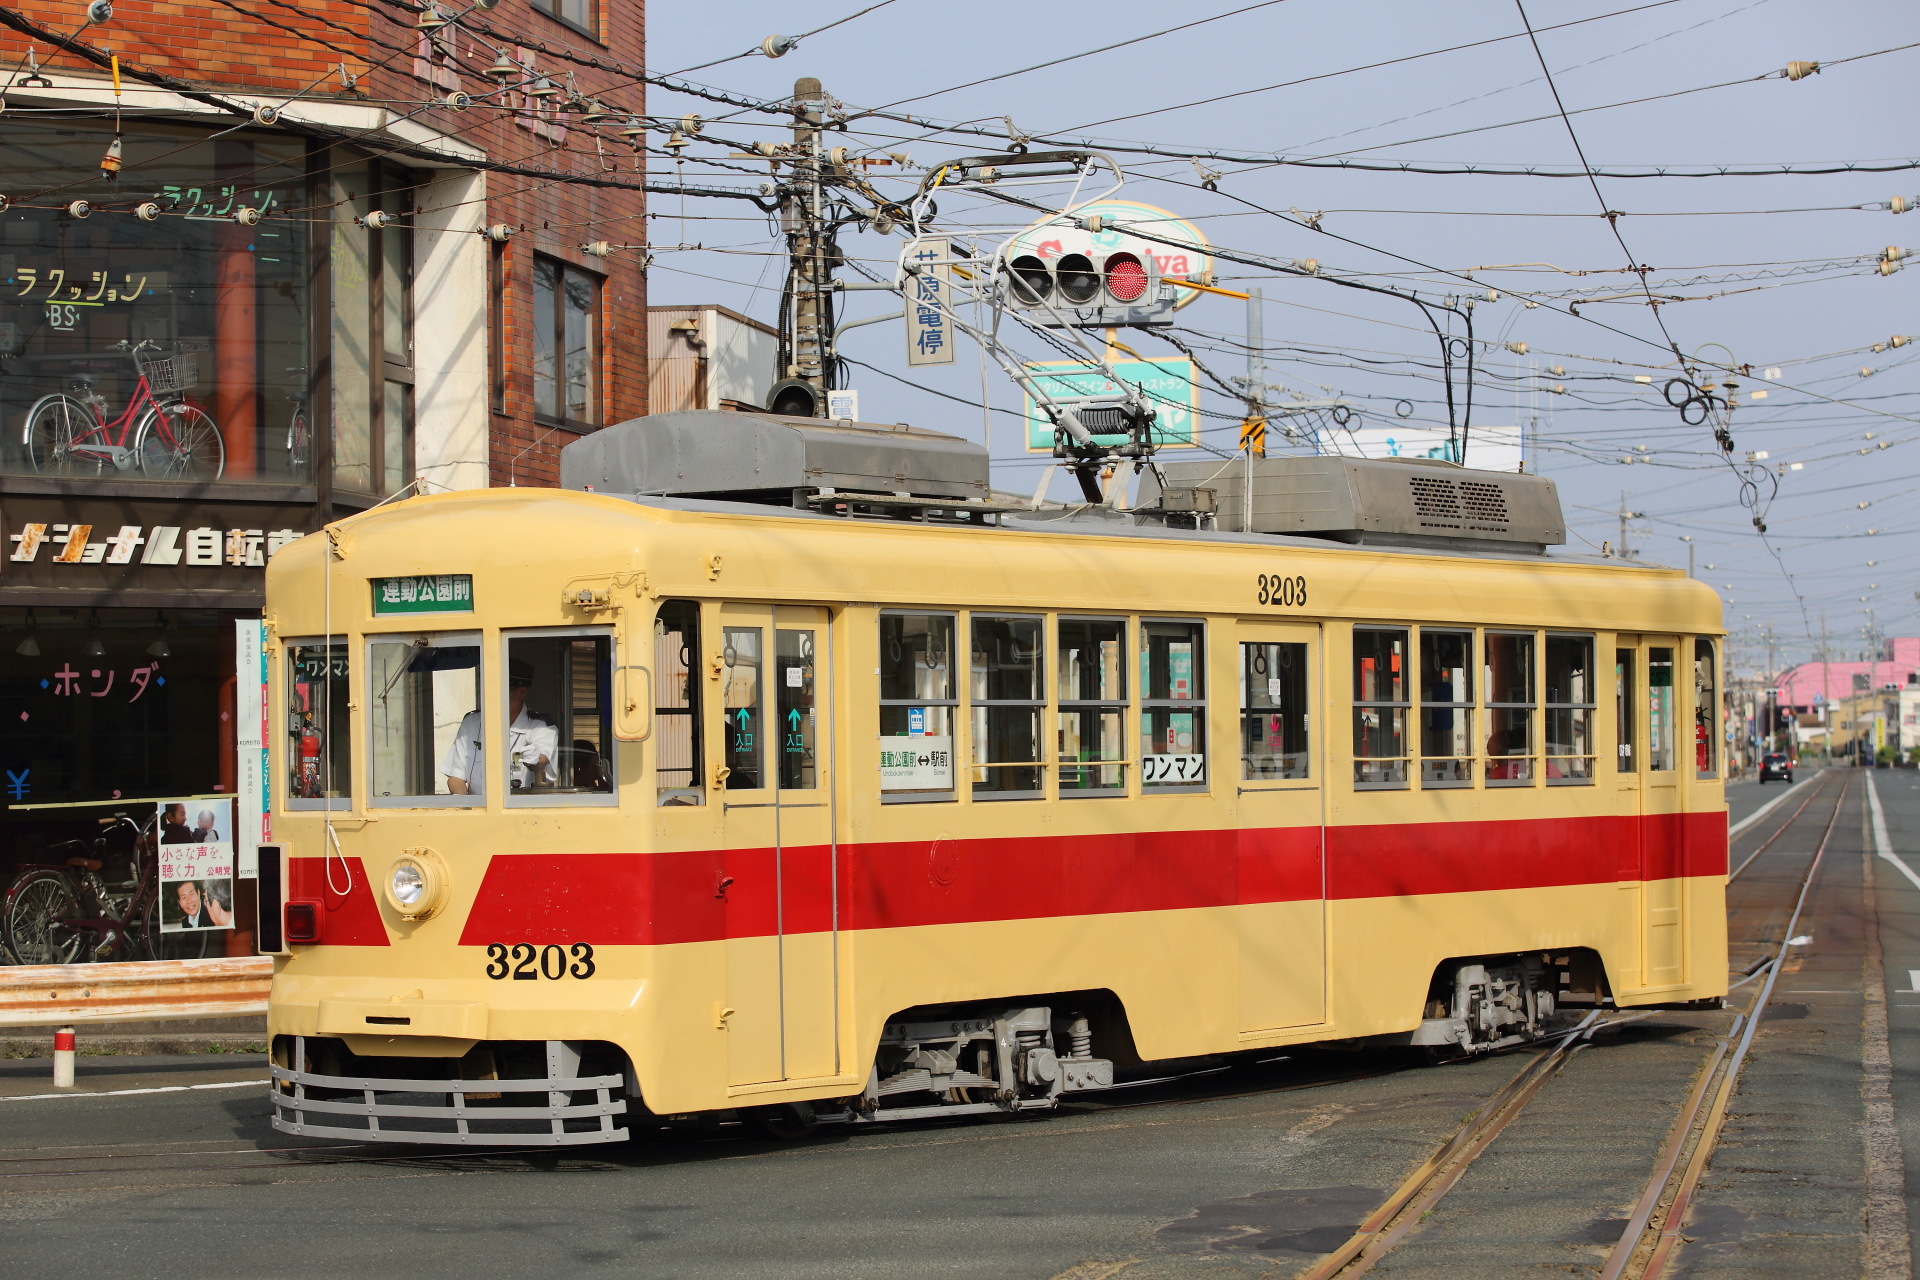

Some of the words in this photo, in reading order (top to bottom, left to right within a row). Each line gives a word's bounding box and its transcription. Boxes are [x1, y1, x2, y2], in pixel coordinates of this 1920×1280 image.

[17, 268, 147, 301] ラクッション
[50, 305, 76, 327] BS
[382, 575, 471, 603] 運動公園前
[1258, 573, 1307, 606] 3203
[54, 661, 159, 704] ホンダ
[735, 733, 753, 747] 入口
[786, 733, 804, 747] 入口
[931, 750, 948, 768] 駅前
[1143, 756, 1203, 781] ワンマン
[206, 865, 232, 877] 公明党
[486, 942, 596, 981] 3203
